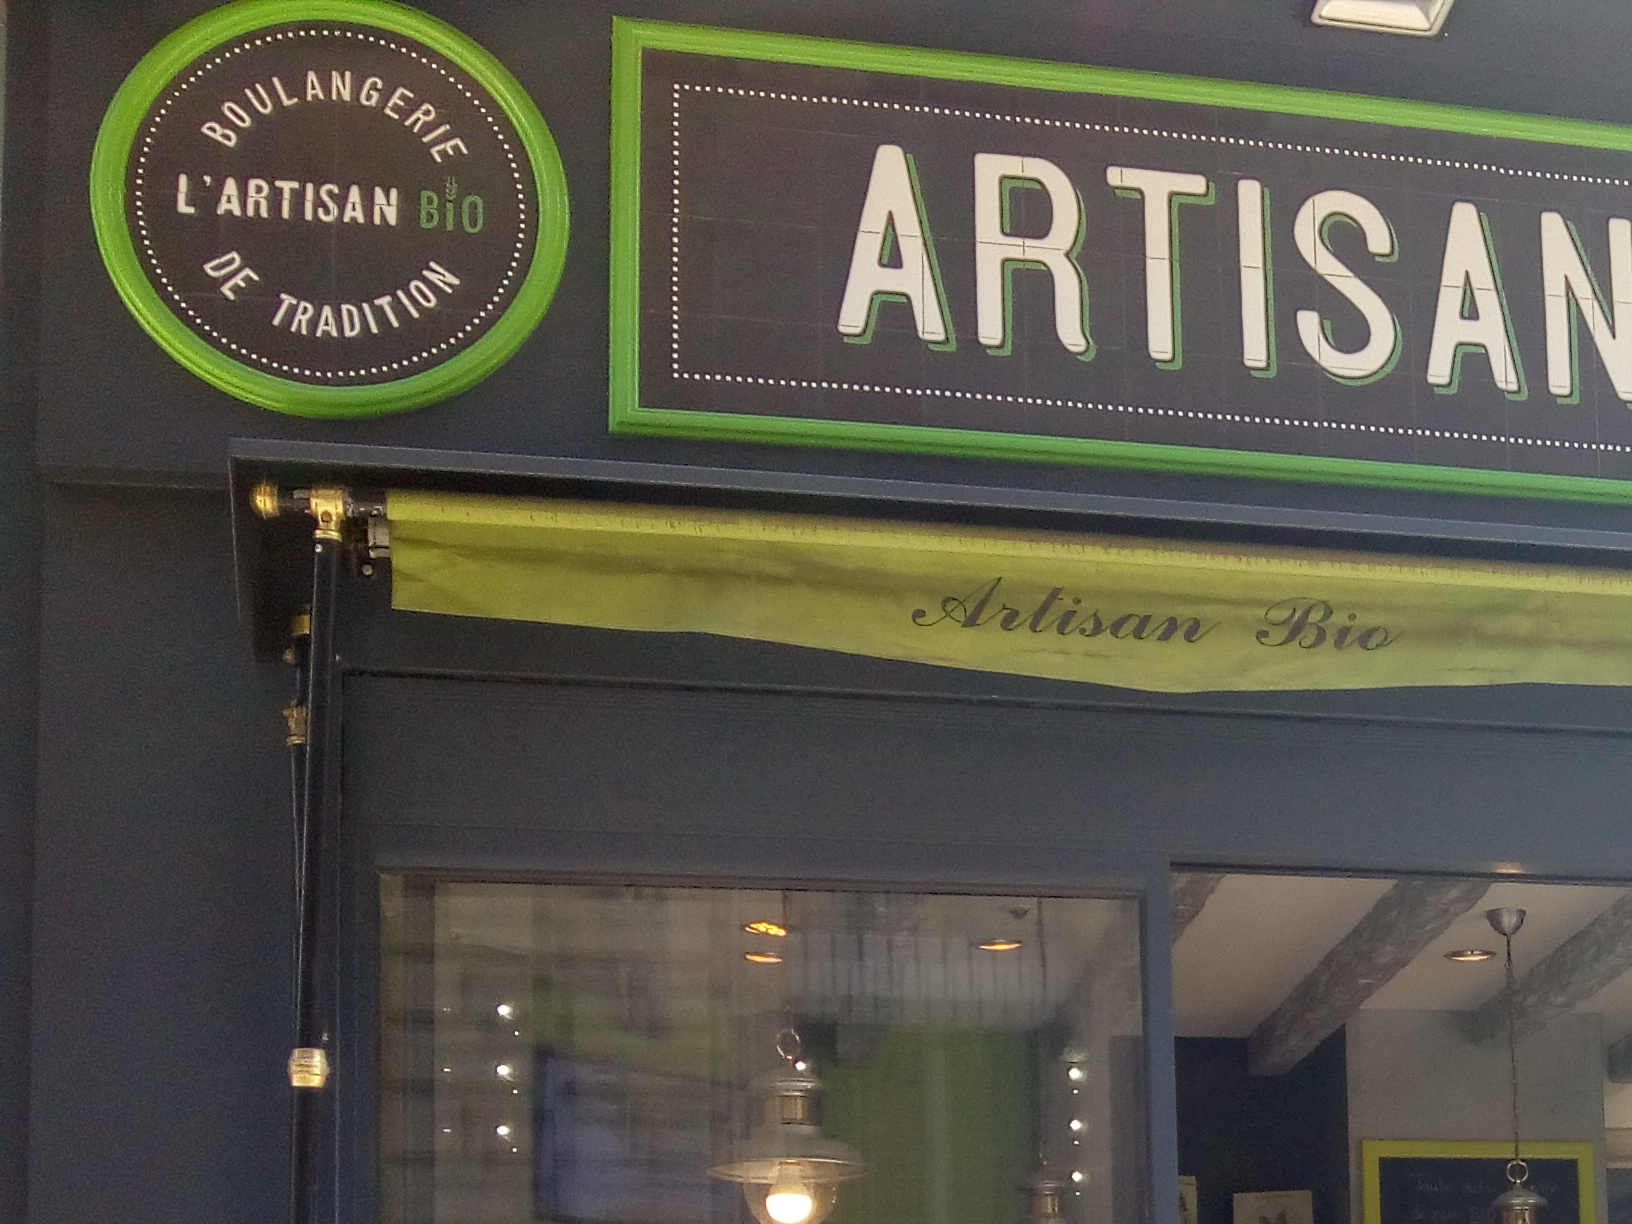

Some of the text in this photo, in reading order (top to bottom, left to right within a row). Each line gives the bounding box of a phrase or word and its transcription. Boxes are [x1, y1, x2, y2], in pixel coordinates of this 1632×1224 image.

[201, 70, 468, 163] BOULANGERIE
[178, 173, 397, 226] L'ARTISAN
[203, 250, 461, 338] DE TRADITION
[912, 576, 1402, 652] Artisan Bio
